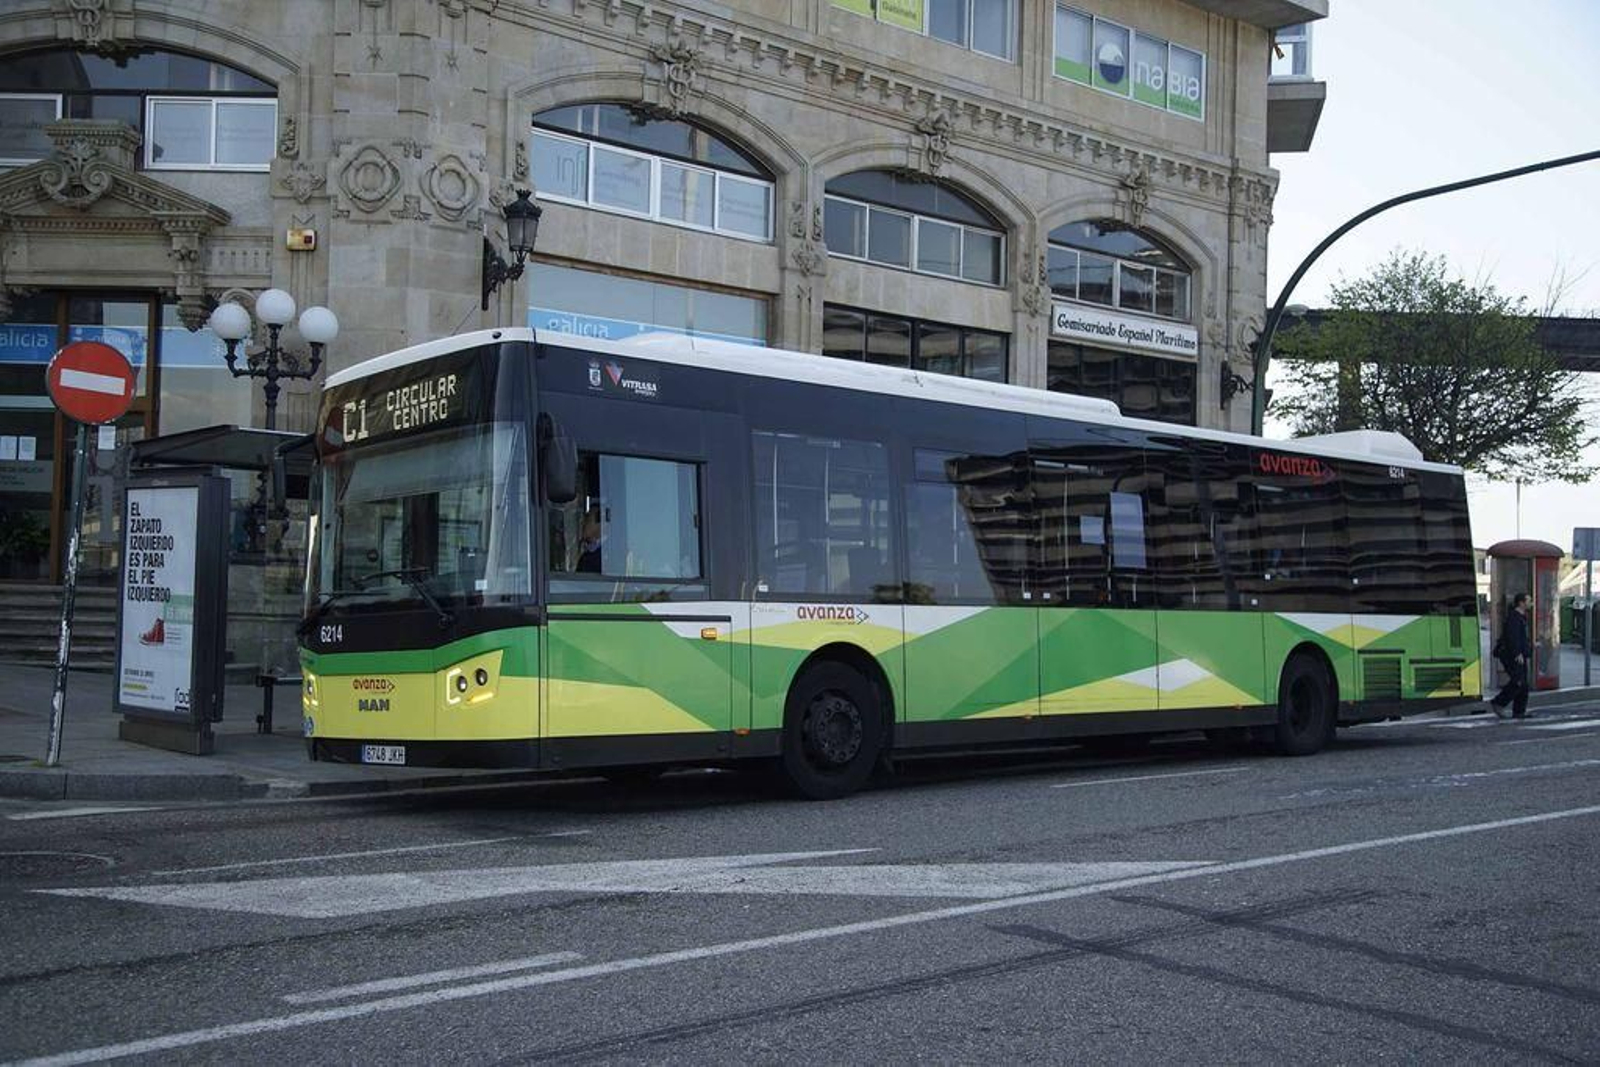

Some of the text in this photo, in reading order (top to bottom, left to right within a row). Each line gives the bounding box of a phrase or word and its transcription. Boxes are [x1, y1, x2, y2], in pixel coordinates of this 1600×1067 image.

[386, 374, 457, 411] CIRCULAR
[621, 379, 657, 391] VITRASA
[343, 399, 369, 443] C1
[393, 398, 448, 430] CENTRO
[1260, 453, 1320, 476] avanza
[131, 502, 141, 516] EL
[130, 518, 162, 533] ZAPATO
[130, 535, 174, 551] IZQUIERDO
[129, 552, 164, 567] ES PARA
[128, 570, 155, 584] EL PIE
[127, 586, 171, 603] IZQUIERDO
[797, 606, 855, 620] avanza
[320, 625, 343, 643] 6214
[353, 679, 387, 690] avanza
[359, 699, 390, 712] MAN
